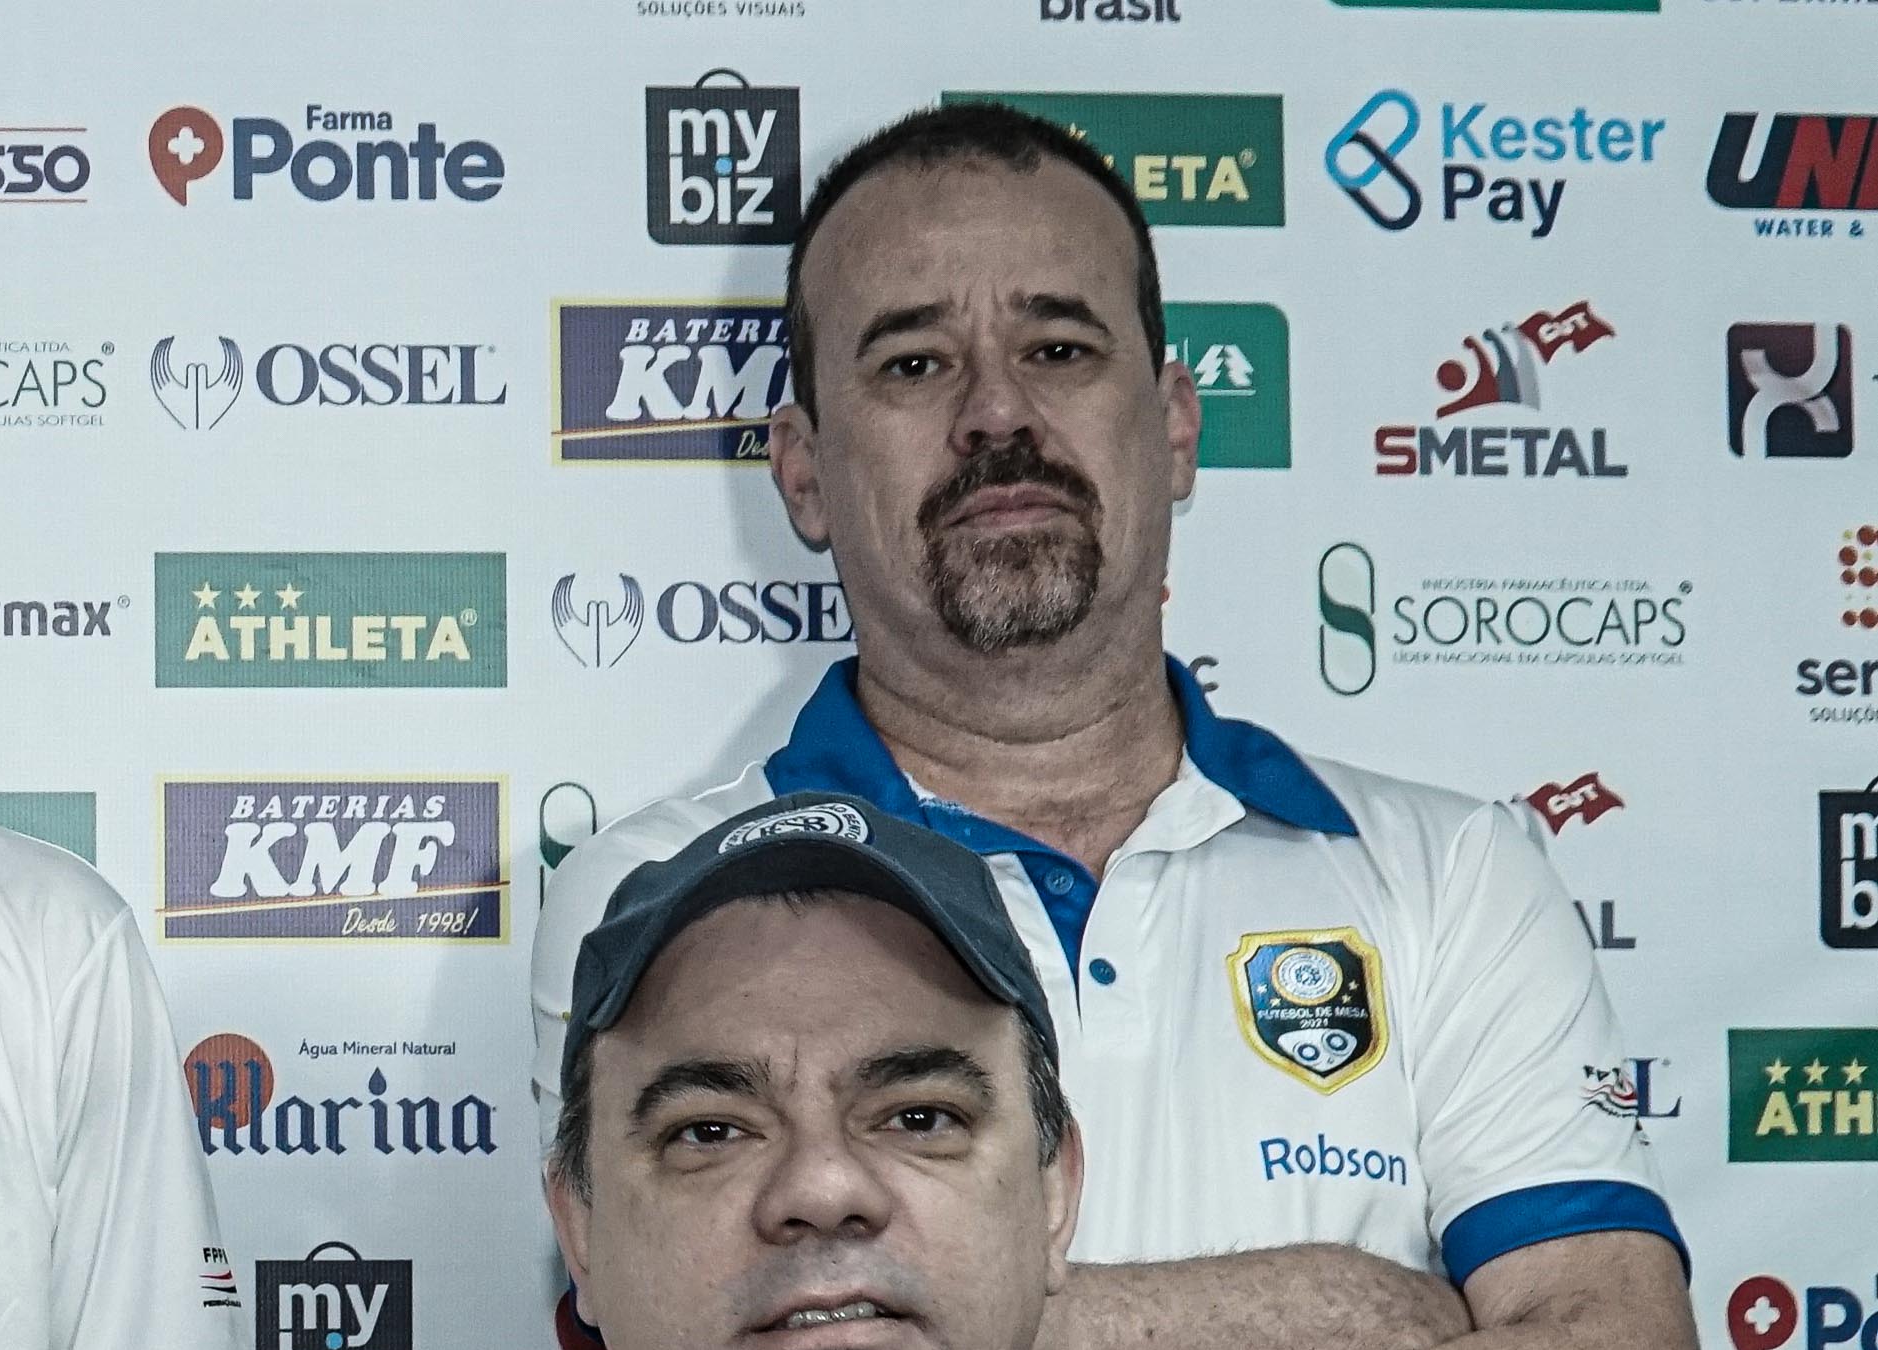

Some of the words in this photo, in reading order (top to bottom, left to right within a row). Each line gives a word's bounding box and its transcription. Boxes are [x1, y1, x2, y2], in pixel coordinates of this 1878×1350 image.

[306, 104, 393, 133] Farma
[668, 108, 778, 173] my
[1443, 103, 1666, 164] Kester
[232, 118, 506, 202] Ponte
[668, 153, 775, 226] biz
[1443, 166, 1566, 238] Pay
[1755, 218, 1834, 238] WATER
[625, 317, 791, 344] BATERI
[256, 343, 507, 406] OSSEL
[604, 345, 798, 421] KM
[1374, 425, 1628, 479] SMETAL
[185, 614, 470, 663] ATHLETA
[656, 580, 857, 645] OSSE
[1393, 595, 1686, 647] SOROCAPS
[230, 794, 448, 820] BATERIAS
[209, 819, 455, 899] KMF
[341, 907, 397, 936] Desde
[415, 909, 479, 935] 1998!
[298, 1038, 337, 1057] Água
[343, 1038, 397, 1055] Mineral
[402, 1038, 456, 1055] Natural
[1259, 1134, 1408, 1187] Robson
[278, 1281, 389, 1347] my
